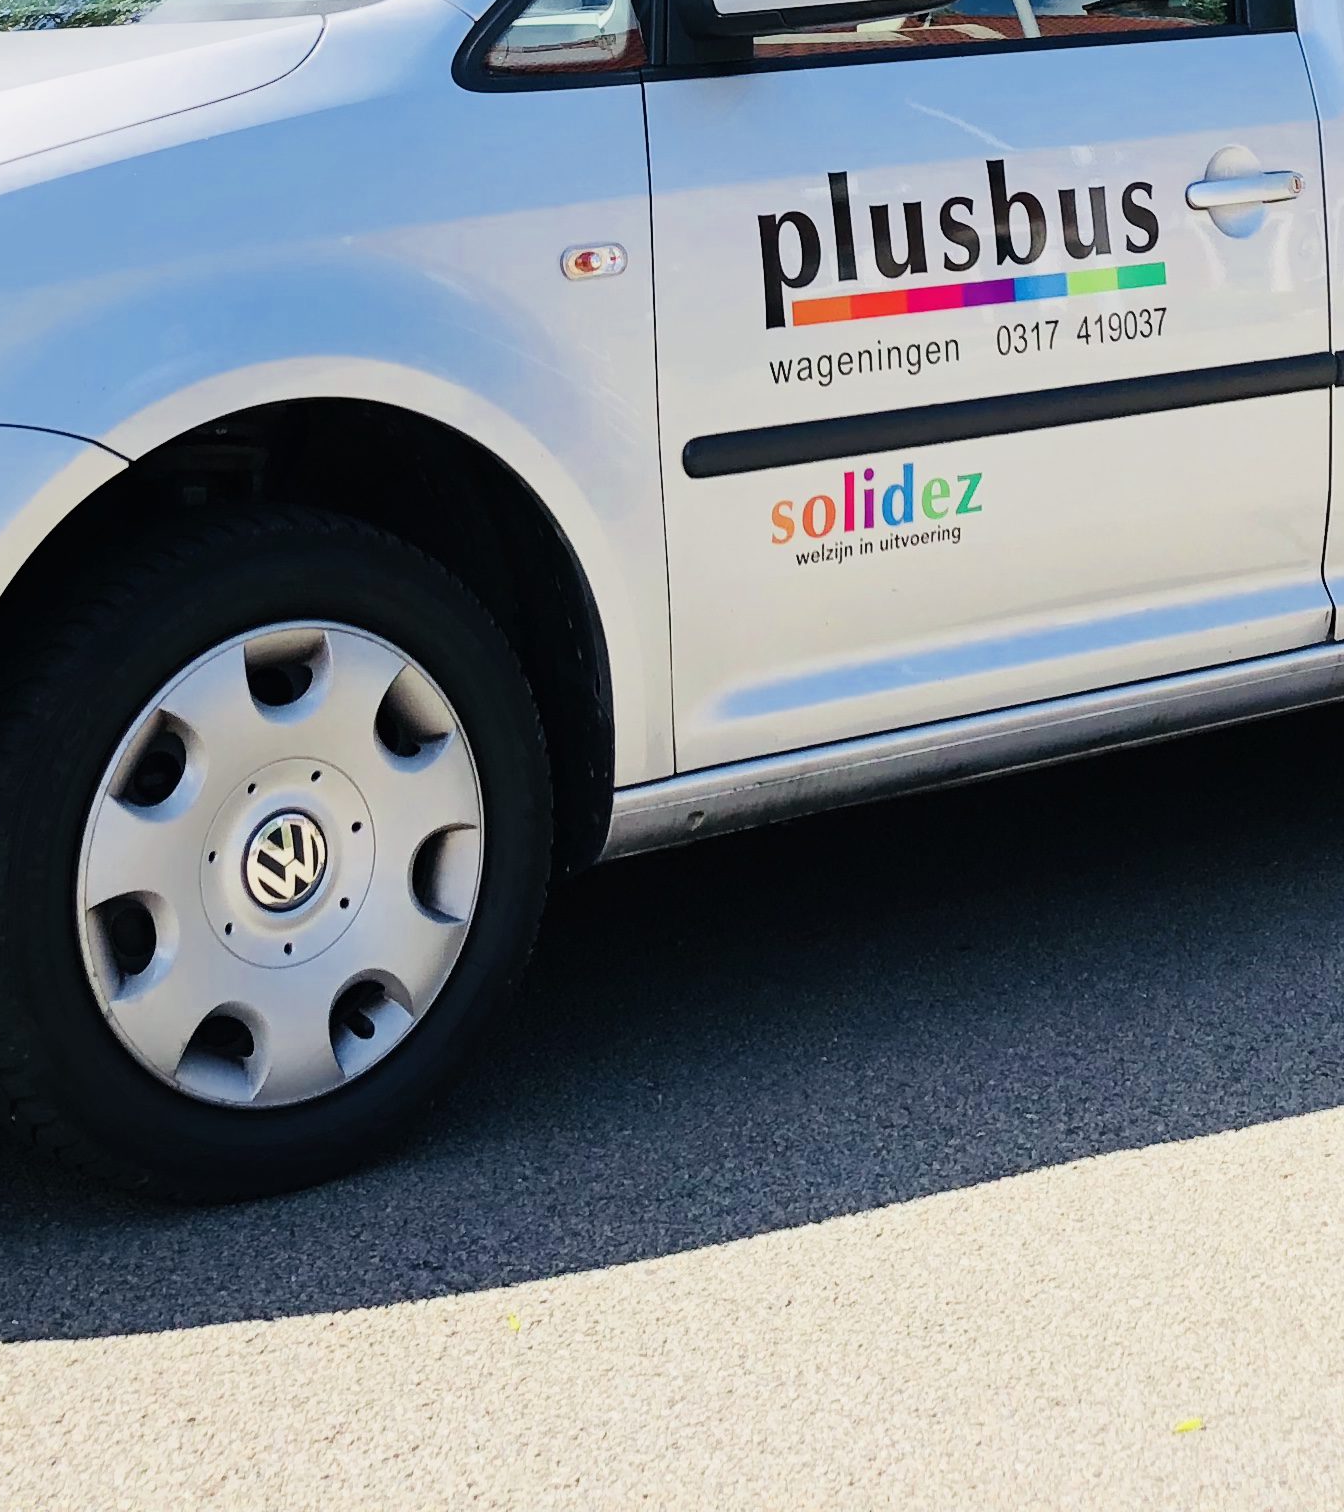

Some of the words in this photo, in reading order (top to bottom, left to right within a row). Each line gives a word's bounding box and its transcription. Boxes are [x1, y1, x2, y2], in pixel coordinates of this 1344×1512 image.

[758, 160, 1159, 329] plusbus
[769, 338, 960, 387] wageningen
[996, 320, 1060, 356] 0317
[1076, 307, 1168, 345] 419037
[771, 463, 983, 545] solidez
[795, 540, 854, 567] welzijn
[859, 537, 874, 555] in
[879, 524, 962, 552] uitvoering
